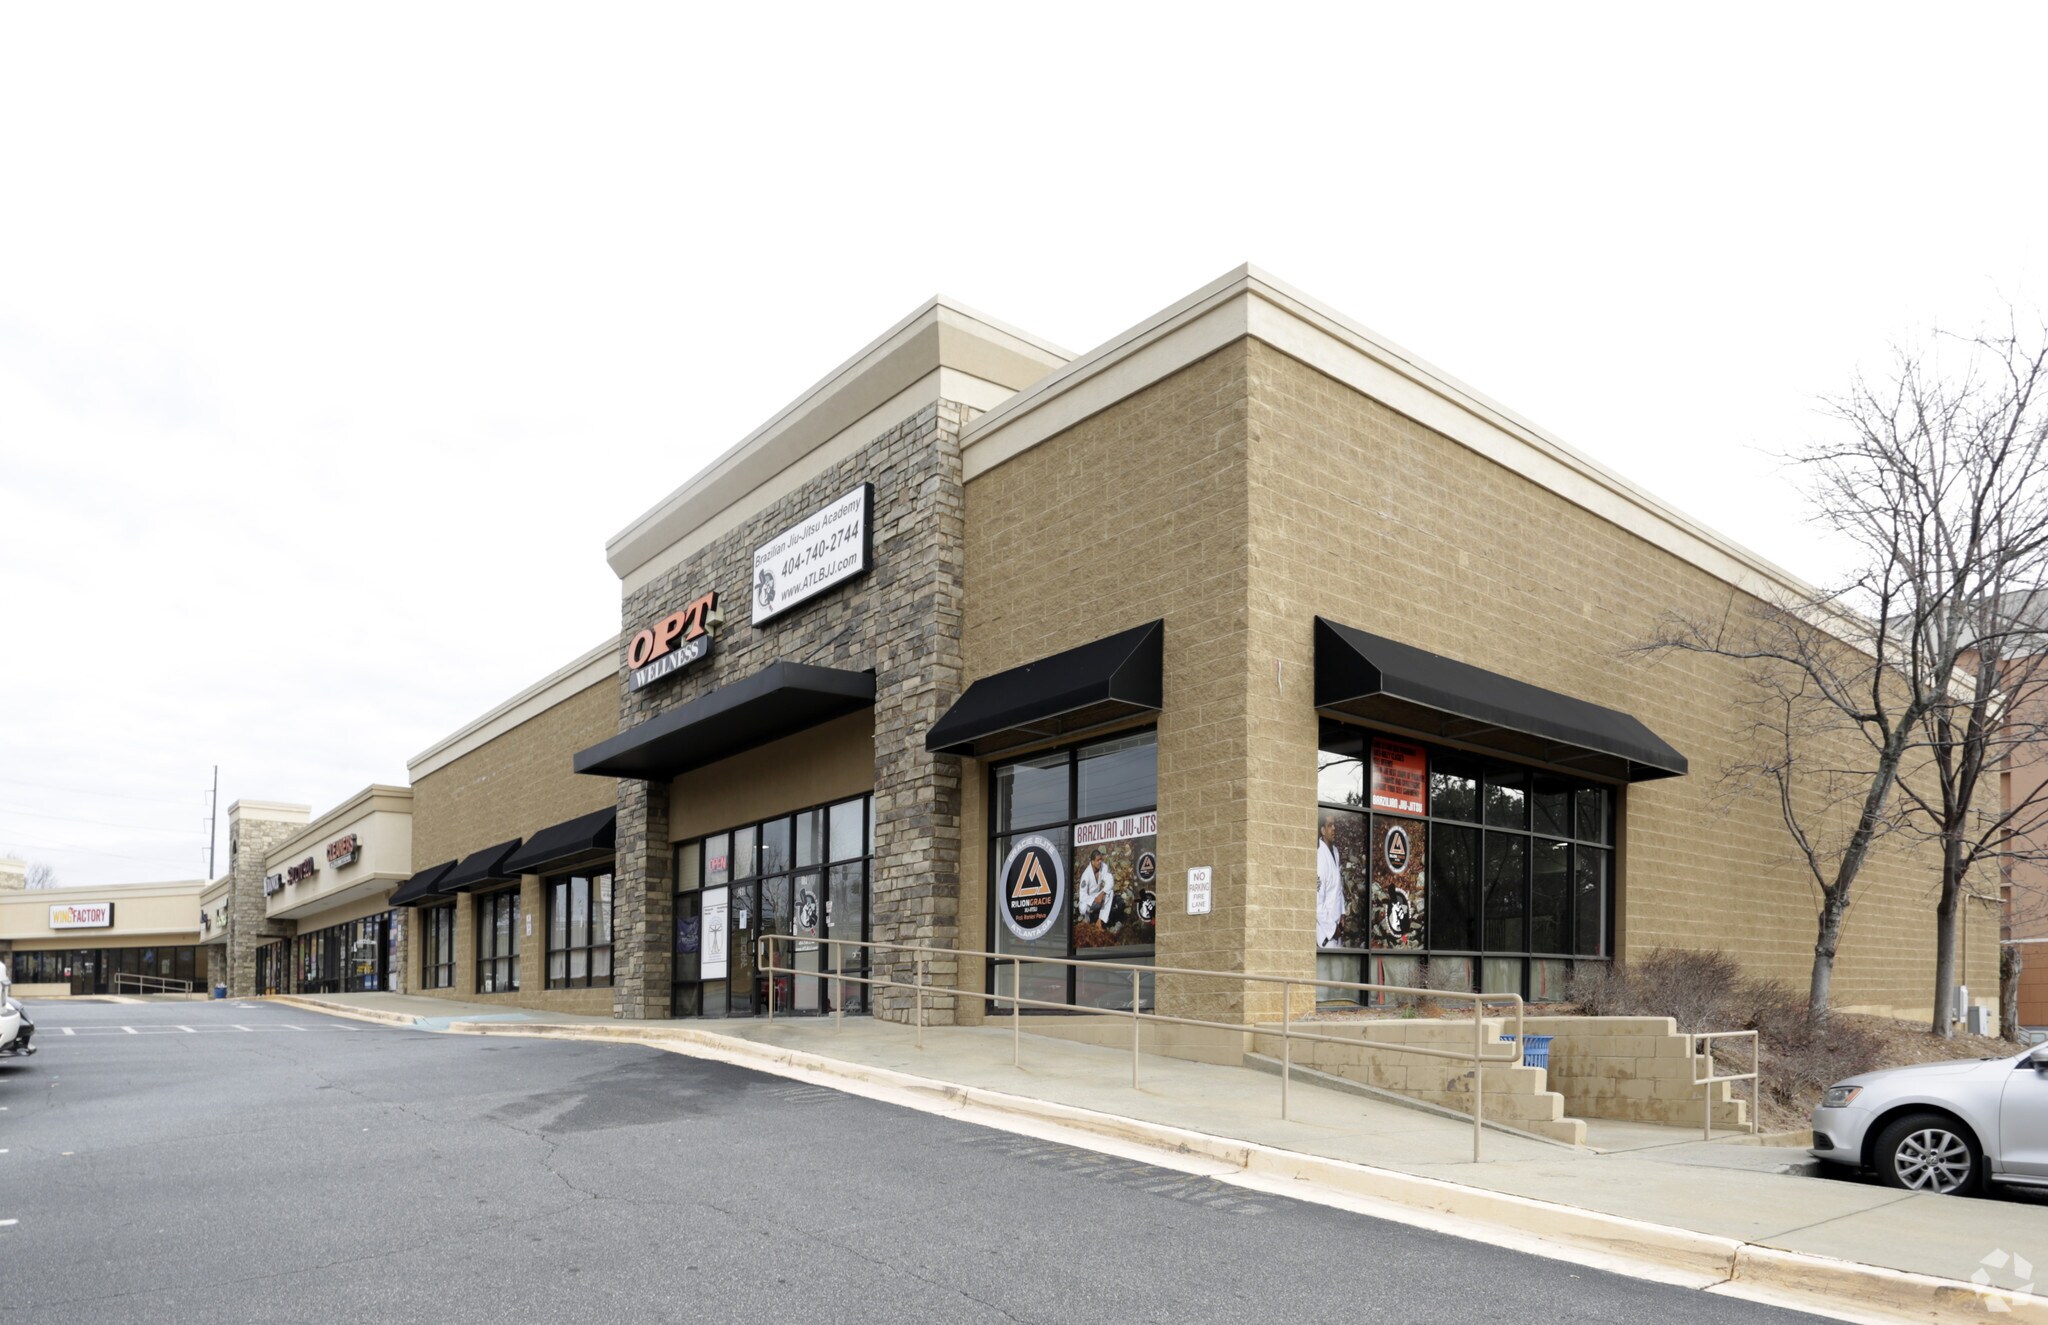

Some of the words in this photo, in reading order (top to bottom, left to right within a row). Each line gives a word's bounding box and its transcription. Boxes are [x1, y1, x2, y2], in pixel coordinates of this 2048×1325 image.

[755, 541, 786, 568] Brazilian
[787, 520, 821, 548] Jiu-Jitsu
[821, 497, 862, 529] Academy
[781, 519, 860, 577] 404-740-2744
[781, 553, 857, 601] www.ATLBJJ.com
[627, 591, 716, 670] OPT
[636, 640, 699, 687] WELLNESS
[1077, 820, 1118, 844] BRAZILIAN
[1008, 837, 1033, 862] GRACIE
[1034, 837, 1055, 855] ELITE
[709, 856, 727, 871] OPEN
[1189, 882, 1210, 892] PARKING
[1193, 872, 1206, 881] NO
[53, 910, 72, 923] WING
[72, 908, 106, 923] FACTORY
[1191, 900, 1206, 908] LANE
